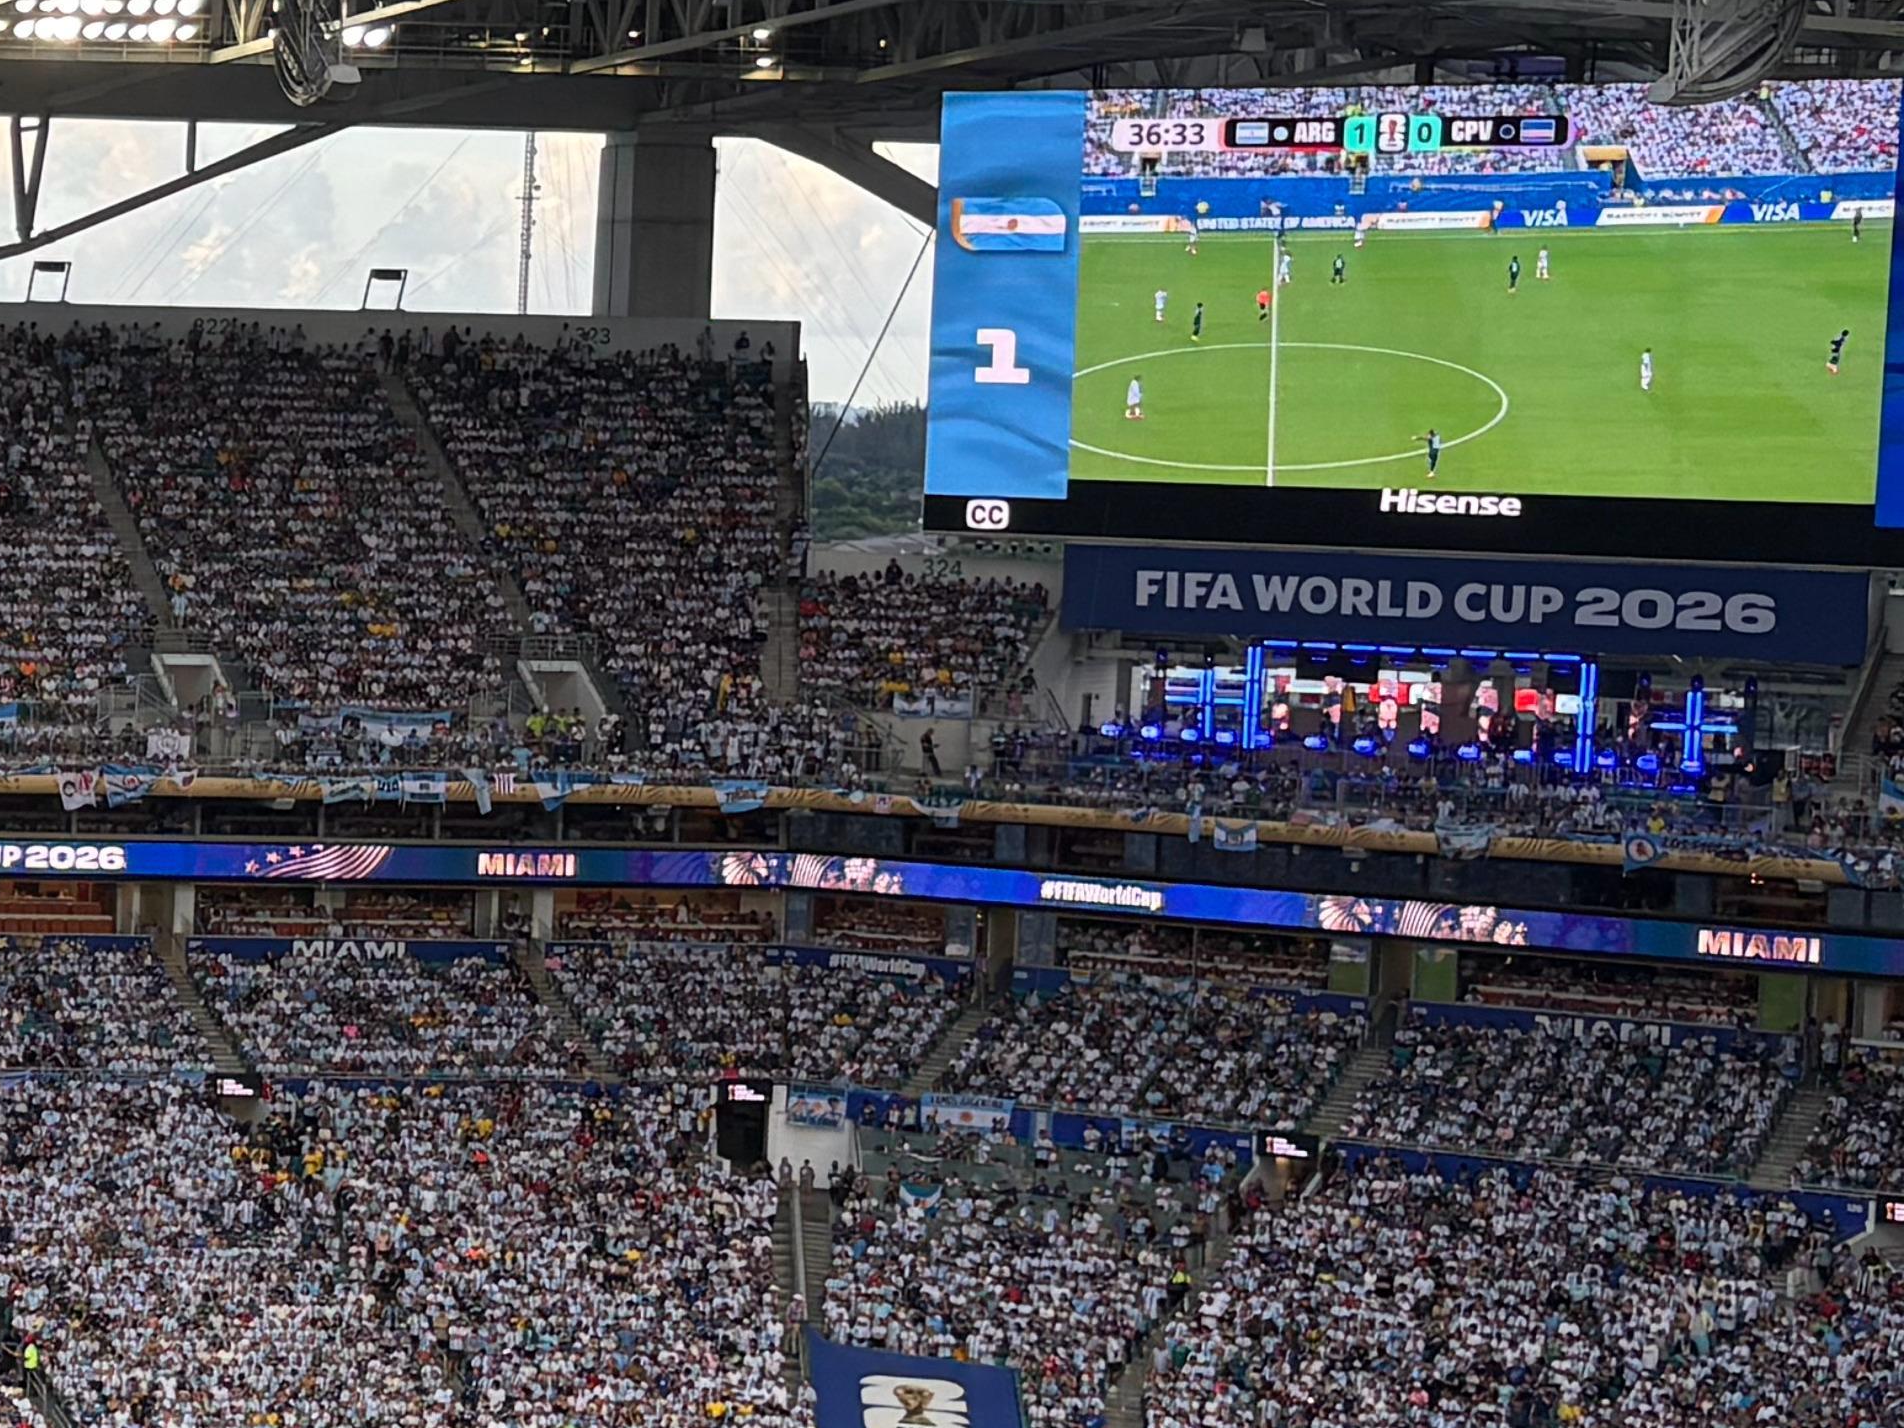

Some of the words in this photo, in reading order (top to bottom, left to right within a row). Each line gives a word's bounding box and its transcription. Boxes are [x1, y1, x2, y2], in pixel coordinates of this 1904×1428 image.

[1129, 122, 1206, 146] 36:33
[1294, 121, 1337, 144] ARG
[1353, 122, 1366, 145] 1
[1417, 122, 1432, 144] 0
[1450, 119, 1493, 143] CPV
[1521, 209, 1569, 227] VISA
[1751, 202, 1801, 222] VISA
[974, 328, 1030, 385] 1
[1379, 488, 1523, 518] Hisense
[970, 504, 1006, 527] CC
[922, 558, 962, 578] 324
[1134, 570, 1243, 612] FIFA
[1251, 574, 1444, 620] WORLD
[1454, 583, 1566, 624] CUP
[1573, 588, 1779, 633] 2026
[24, 846, 127, 871] 2026
[477, 852, 576, 877] MIAMI
[1039, 880, 1165, 911] #FIFAWorldCup
[1697, 928, 1821, 964] MIAMI
